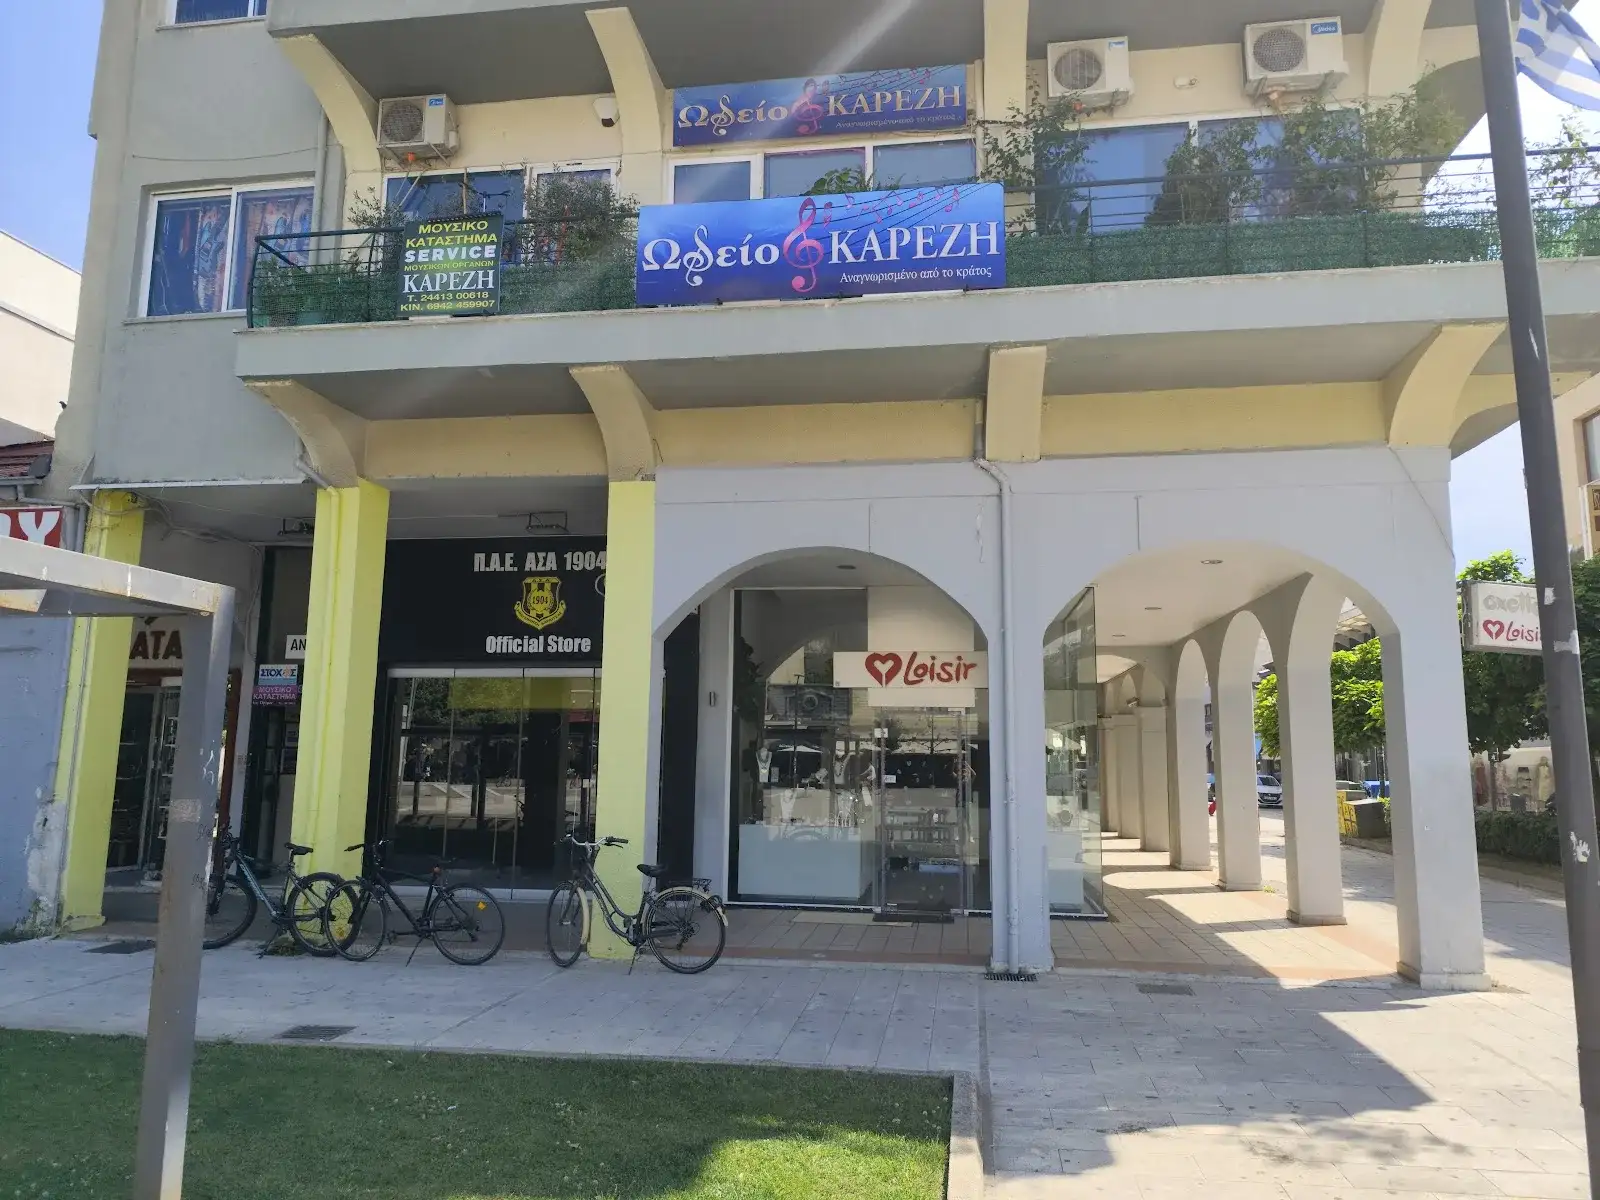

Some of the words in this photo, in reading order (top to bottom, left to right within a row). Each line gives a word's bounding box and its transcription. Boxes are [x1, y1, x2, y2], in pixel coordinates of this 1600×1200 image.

[826, 85, 961, 117] ΚΑΡΕΖΗ
[418, 220, 489, 234] ΜΟΥΣΙΚΟ
[405, 233, 498, 248] ΚΑΤΑΣΤΗΜΑ
[404, 244, 497, 263] SERVICE
[642, 224, 779, 287] Ωδείο
[828, 221, 1000, 265] ΚΑΡΕΖΗ
[402, 269, 495, 293] ΚΑΡΕΖΗ
[839, 268, 917, 285] Αναγνωρισμένο
[920, 268, 939, 279] από
[942, 268, 954, 278] το
[956, 264, 992, 281] κράτος
[420, 292, 453, 302] 24413
[455, 291, 489, 300] 00618
[426, 302, 453, 310] 6942
[455, 300, 495, 309] 459907
[473, 552, 518, 572] Π.Α.Ε.
[524, 551, 558, 572] ΑΣΑ
[563, 550, 607, 571] 1904
[1505, 620, 1539, 642] Loisi
[485, 635, 545, 653] Official
[547, 634, 592, 653] Store
[903, 651, 978, 686] Loisir
